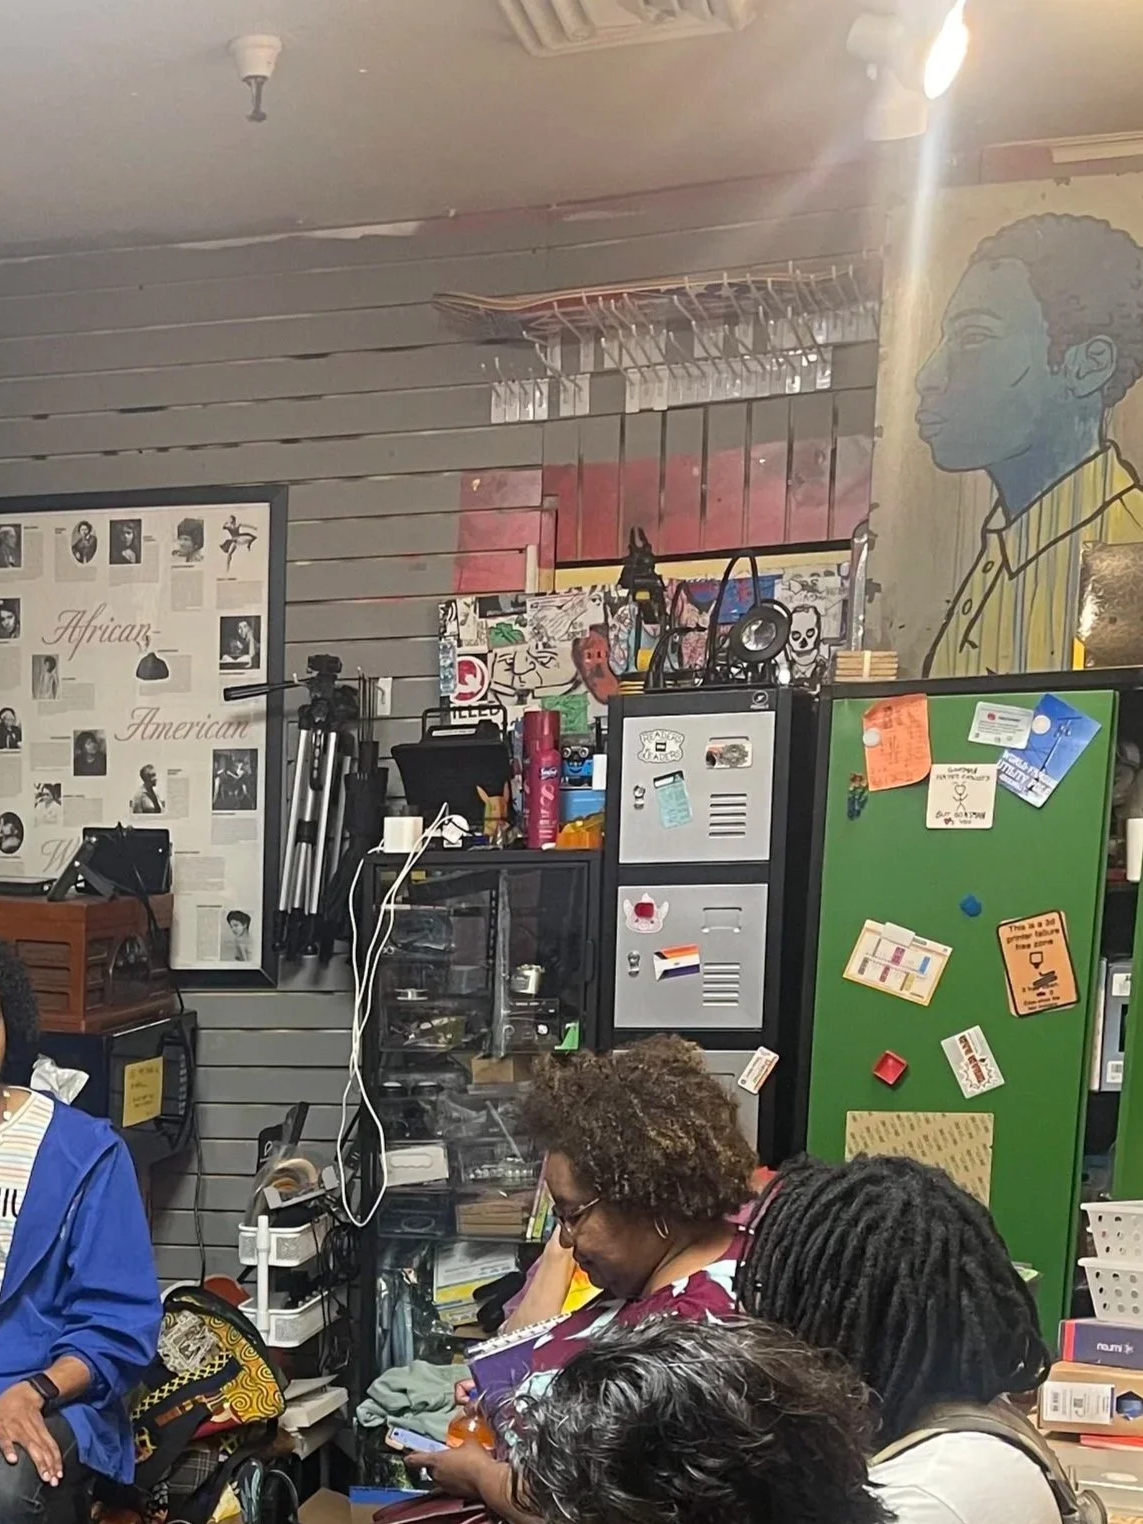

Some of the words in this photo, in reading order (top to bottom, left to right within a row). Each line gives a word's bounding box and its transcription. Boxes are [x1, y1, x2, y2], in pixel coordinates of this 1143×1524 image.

[115, 705, 250, 742] American
[640, 730, 683, 743] READERS
[1009, 924, 1026, 933] This
[1006, 933, 1032, 944] printer
[1034, 939, 1053, 948] zone
